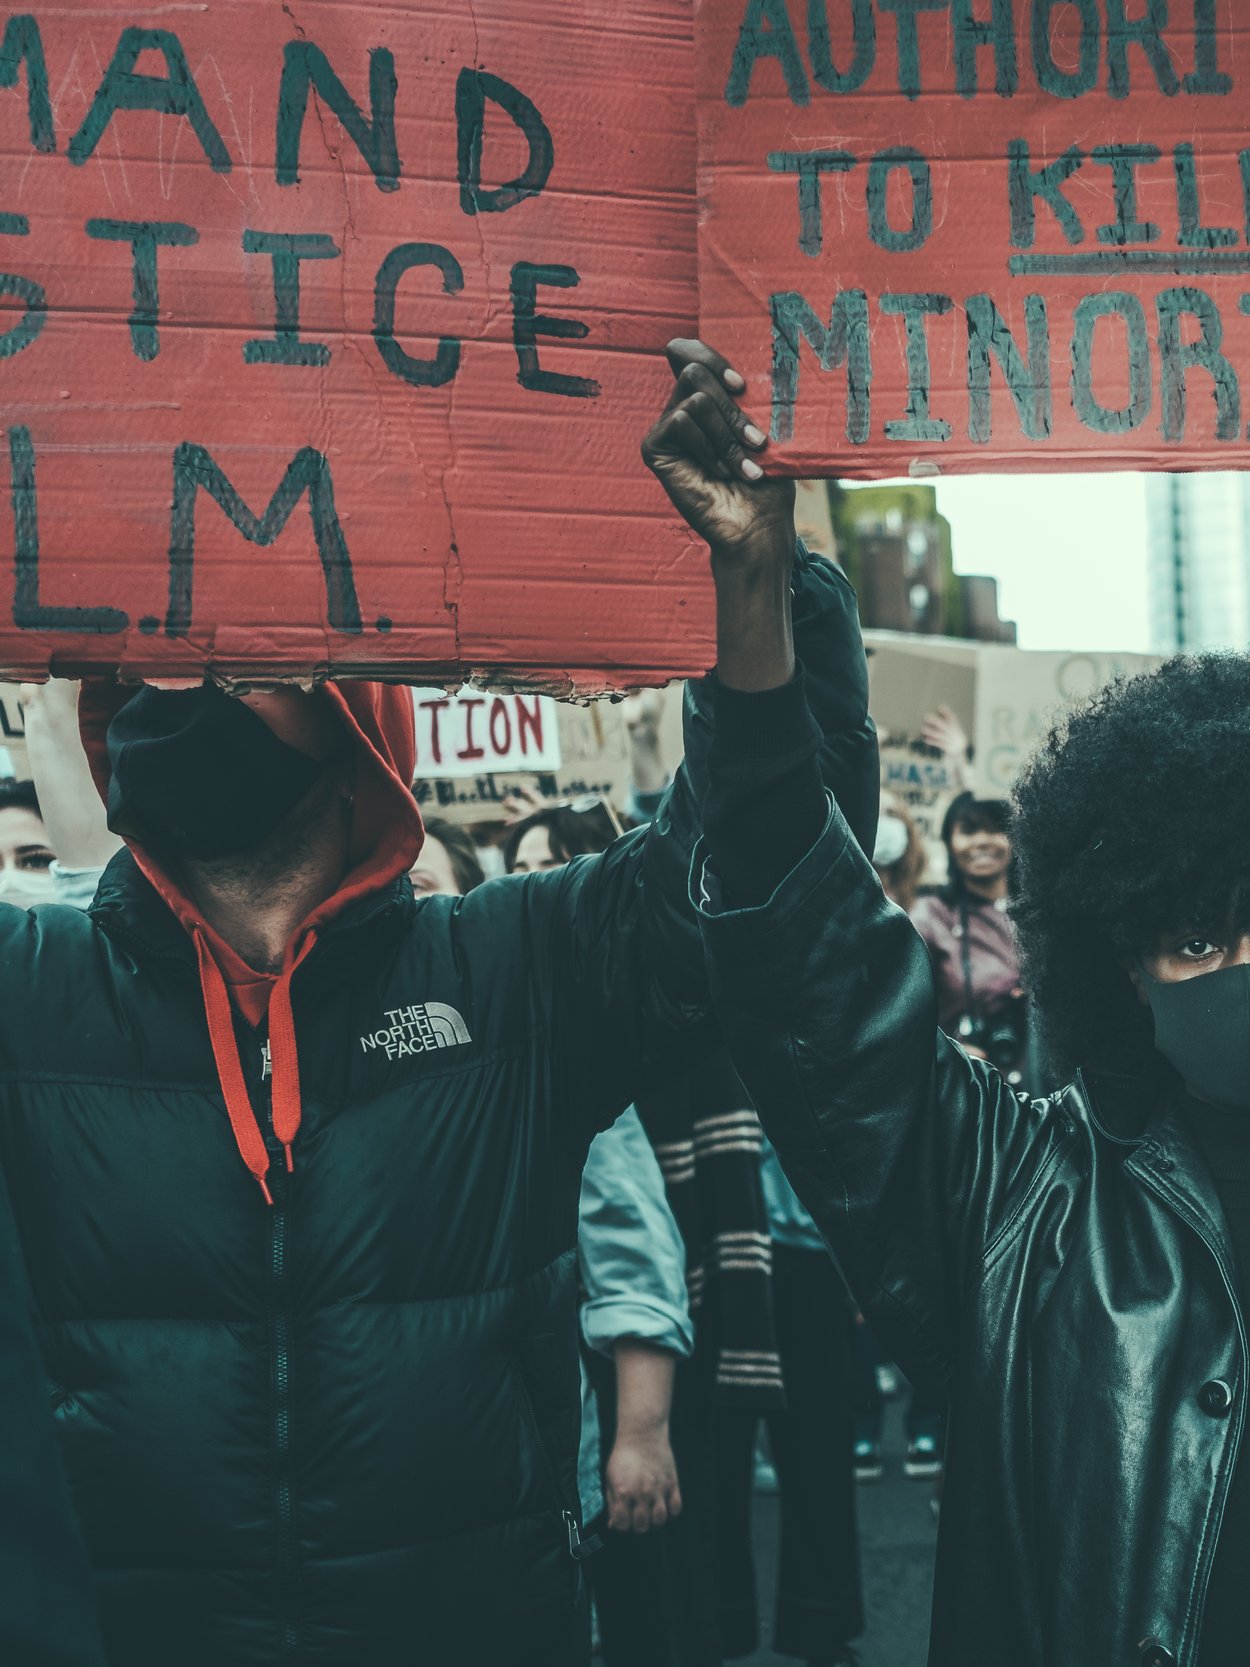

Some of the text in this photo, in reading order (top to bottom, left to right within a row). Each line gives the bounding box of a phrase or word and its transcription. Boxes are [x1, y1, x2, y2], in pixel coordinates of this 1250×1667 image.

[767, 145, 933, 257] TO
[384, 1004, 428, 1026] THE
[360, 1018, 433, 1053] NORTH
[385, 1034, 438, 1061] FACE
